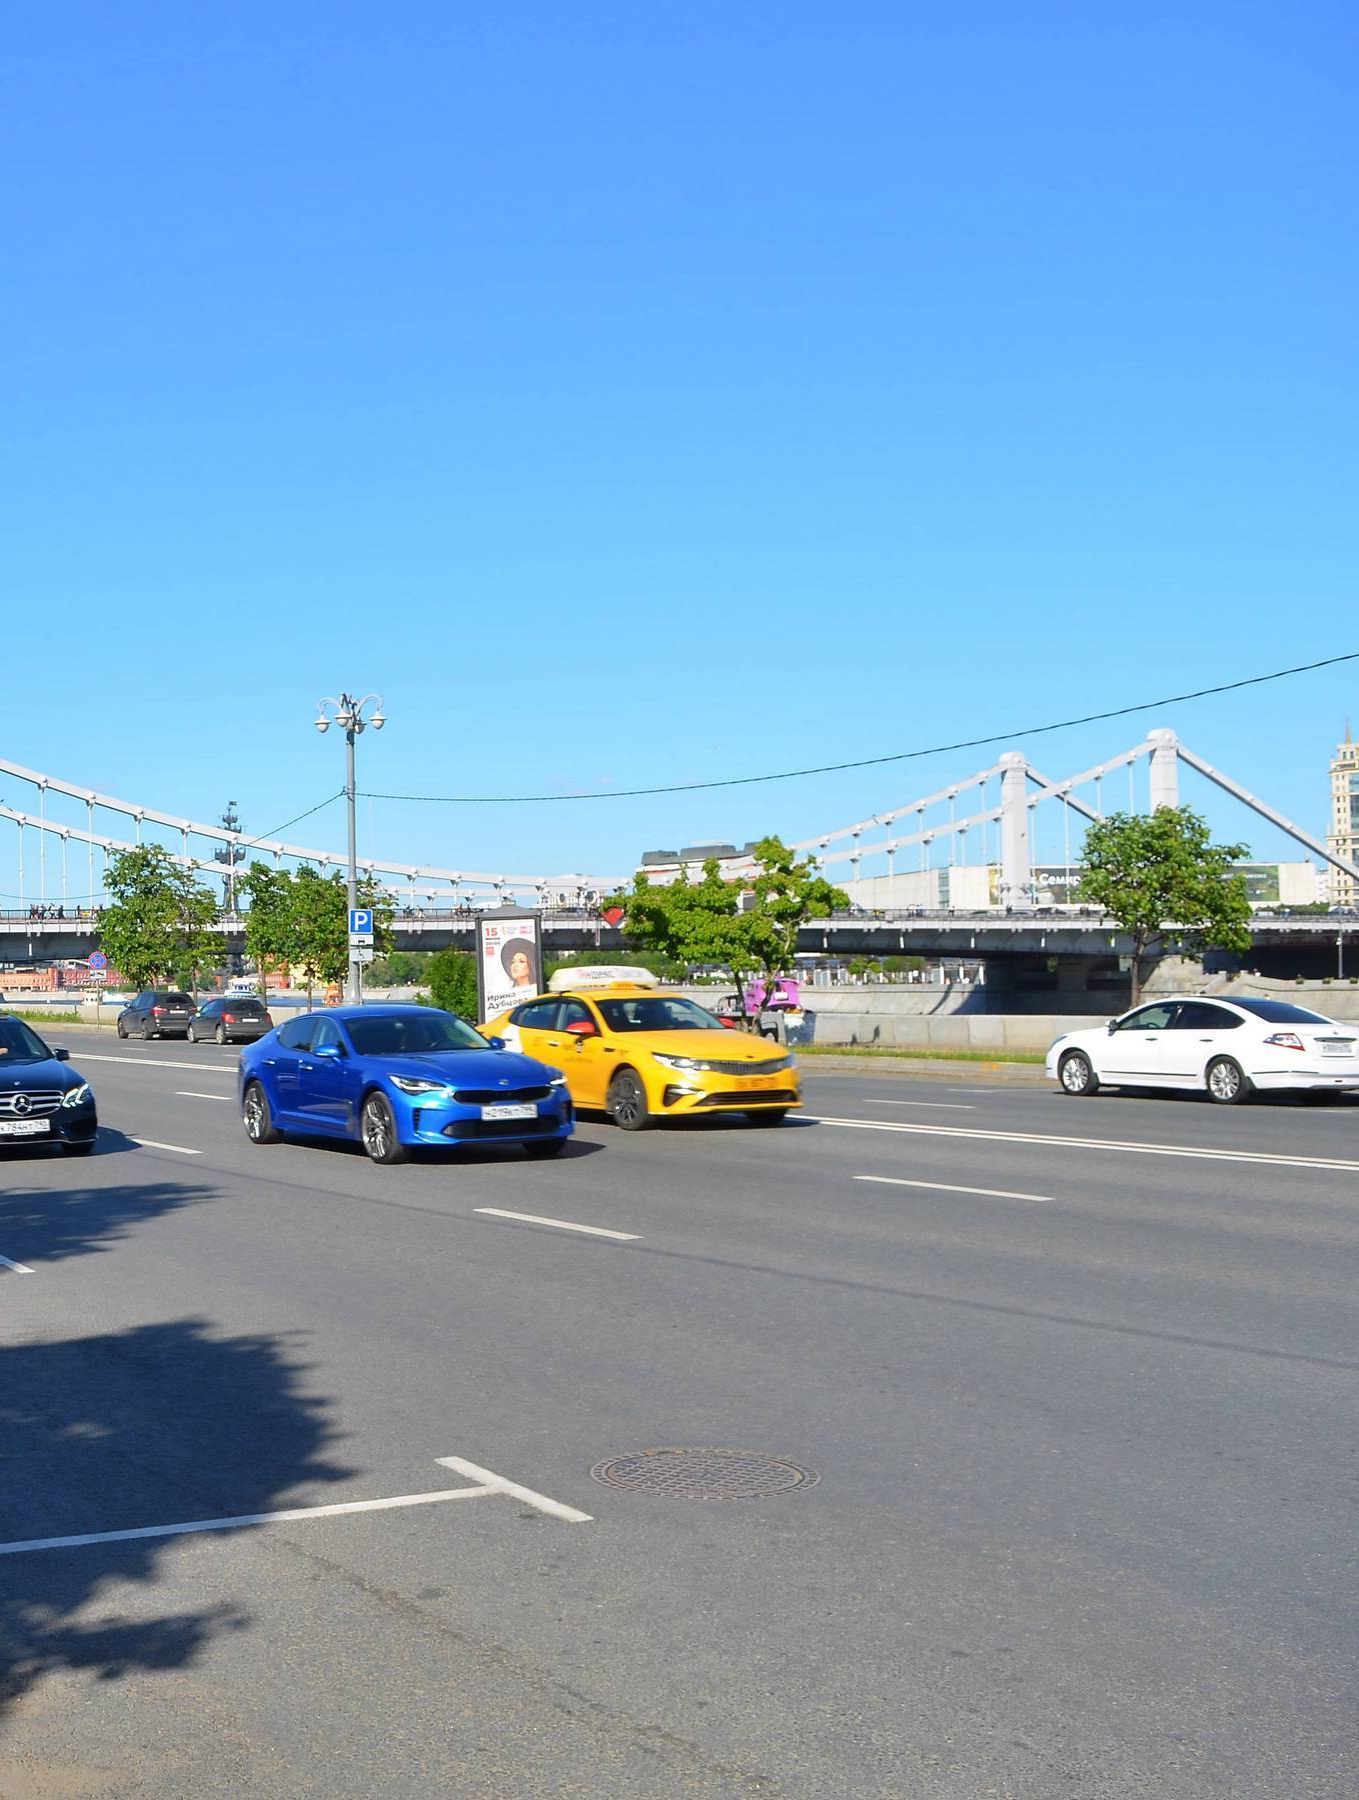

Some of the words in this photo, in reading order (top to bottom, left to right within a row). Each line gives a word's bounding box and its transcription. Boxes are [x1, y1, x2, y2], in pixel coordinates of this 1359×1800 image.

[354, 911, 369, 931] P
[484, 927, 498, 937] 15
[487, 992, 516, 1002] Ирина
